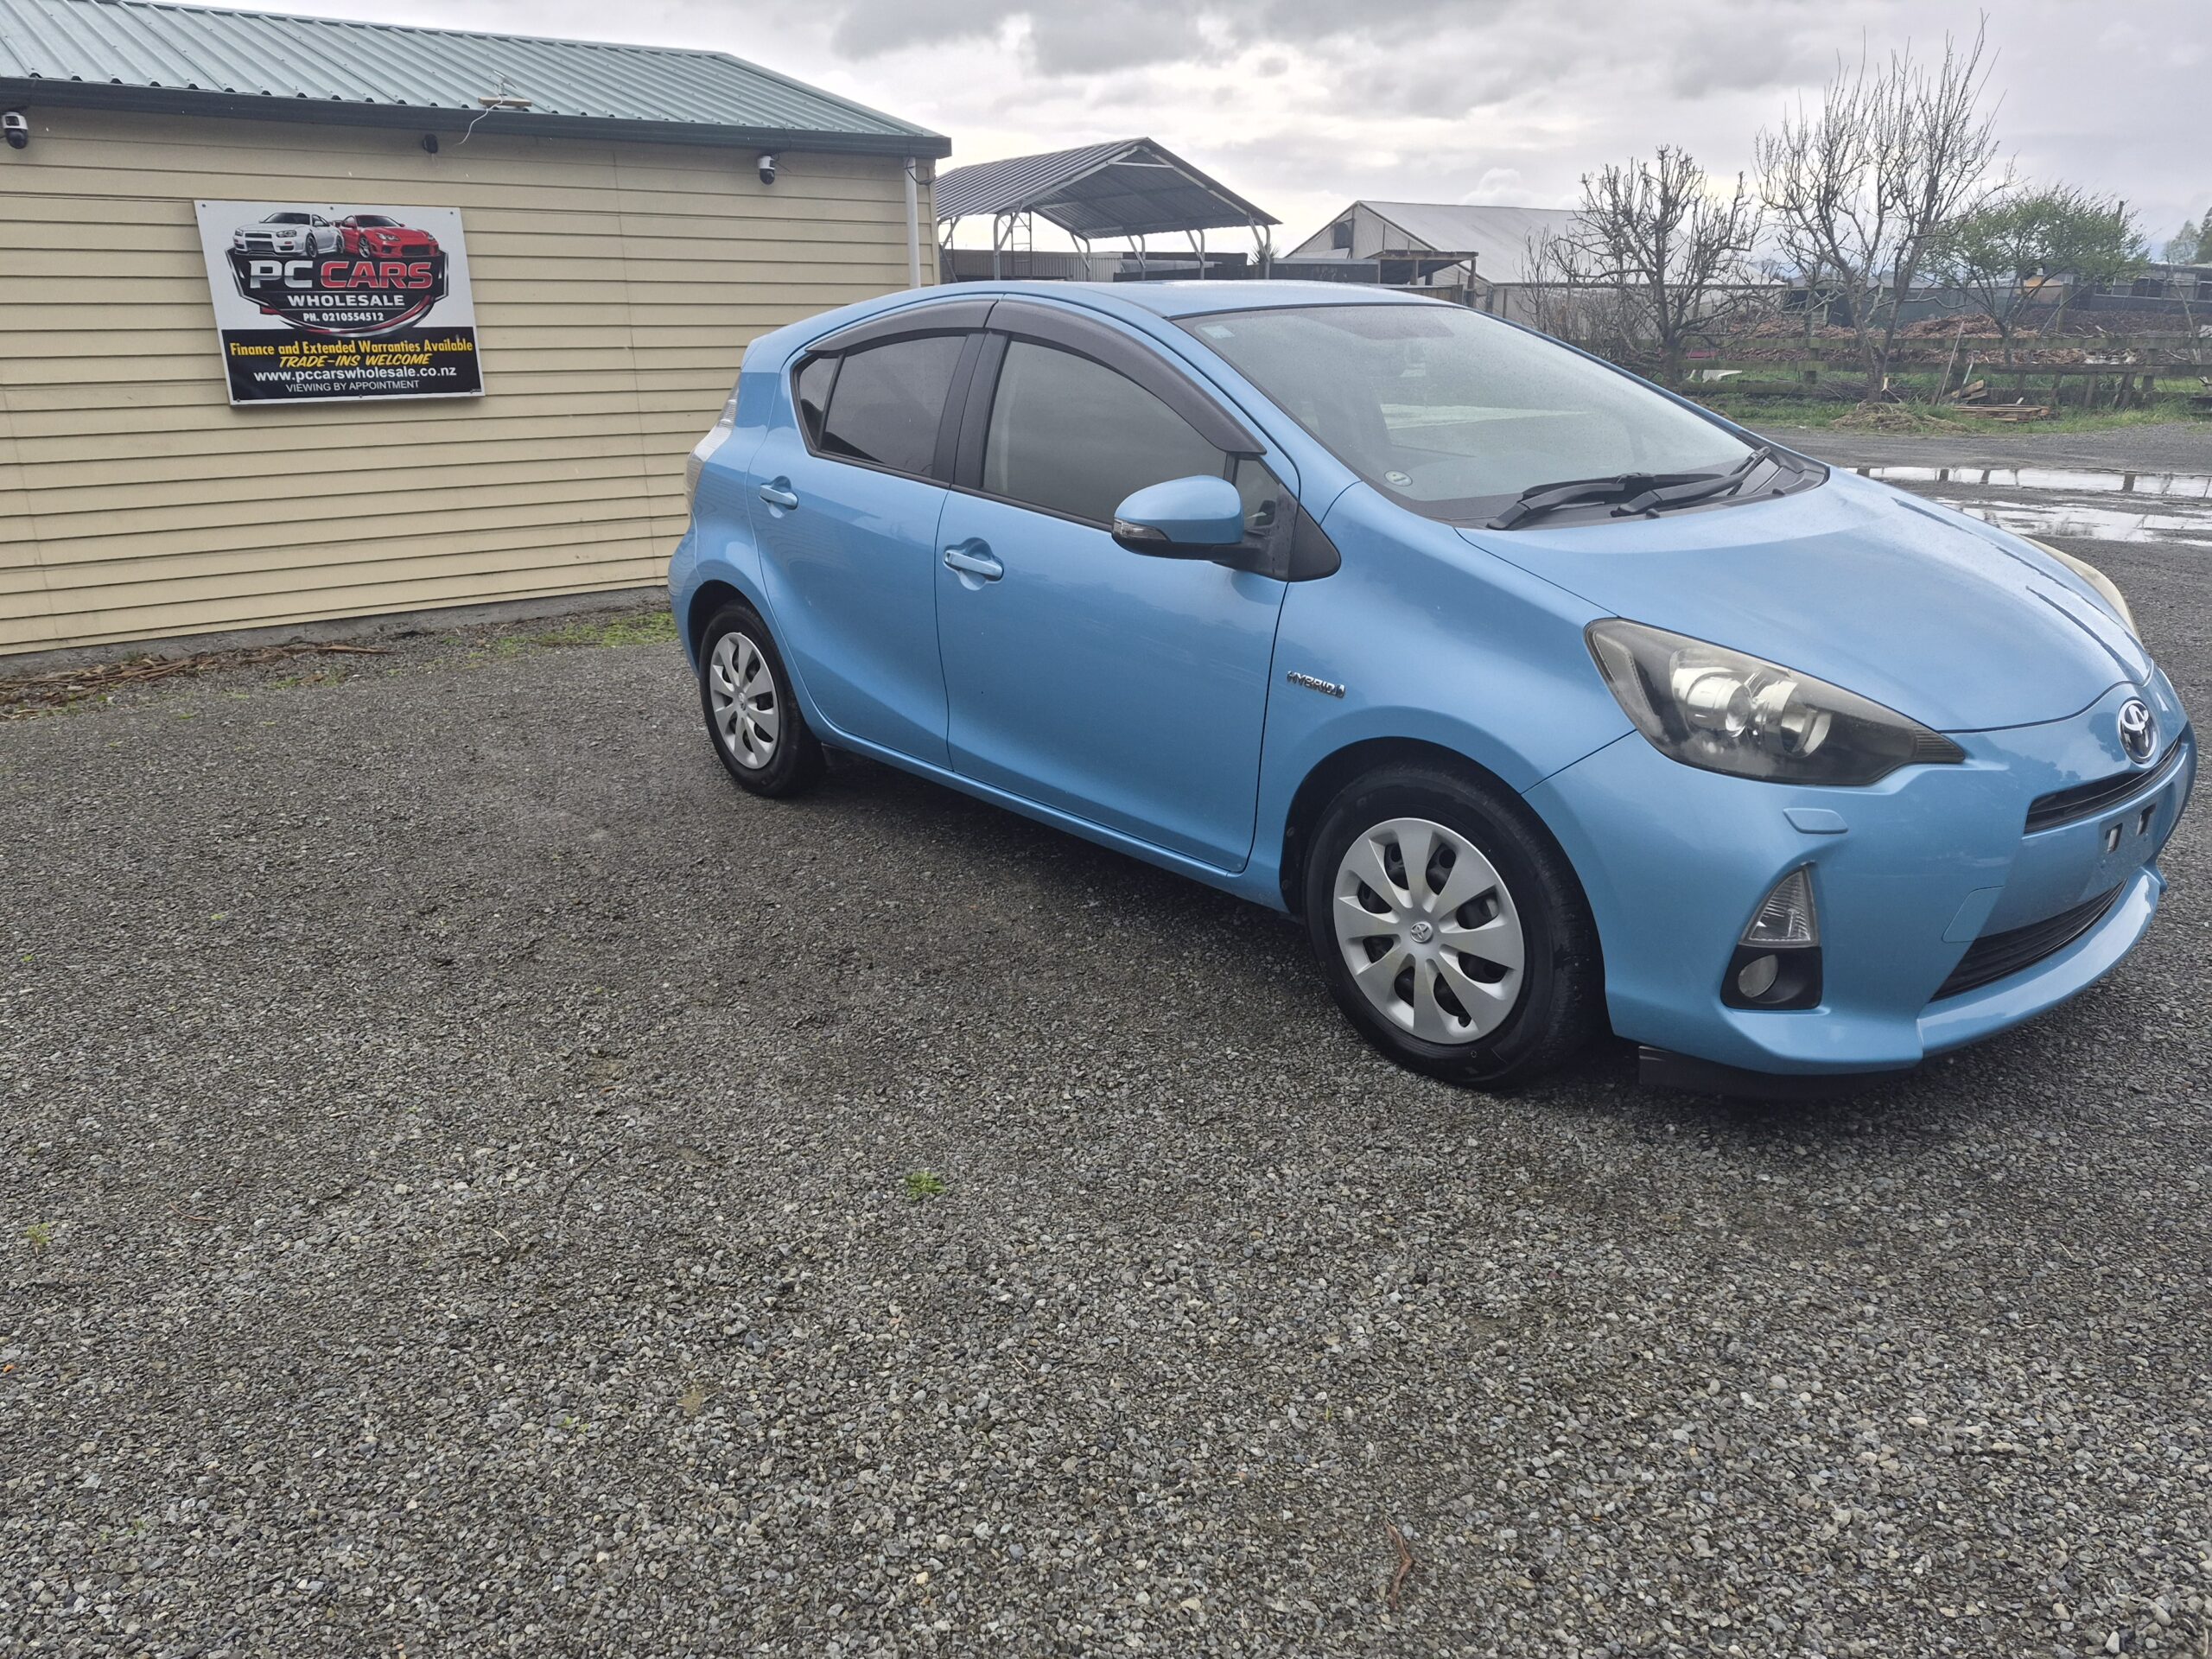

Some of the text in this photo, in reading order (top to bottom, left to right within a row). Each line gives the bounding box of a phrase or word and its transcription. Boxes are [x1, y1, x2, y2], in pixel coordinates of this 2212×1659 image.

[249, 260, 433, 289] PC CARS
[287, 295, 404, 307] WHOLESALE
[302, 312, 385, 322] PH. 0210554512
[230, 338, 473, 356] Finance and Extended Warranties Available
[279, 353, 433, 368] TRADE-INS WELCOME
[253, 365, 457, 384] www.pccarswholesale.co.nz
[285, 379, 420, 392] VIEWING BY APPOINTMENT
[1287, 670, 1337, 696] HYBRID
